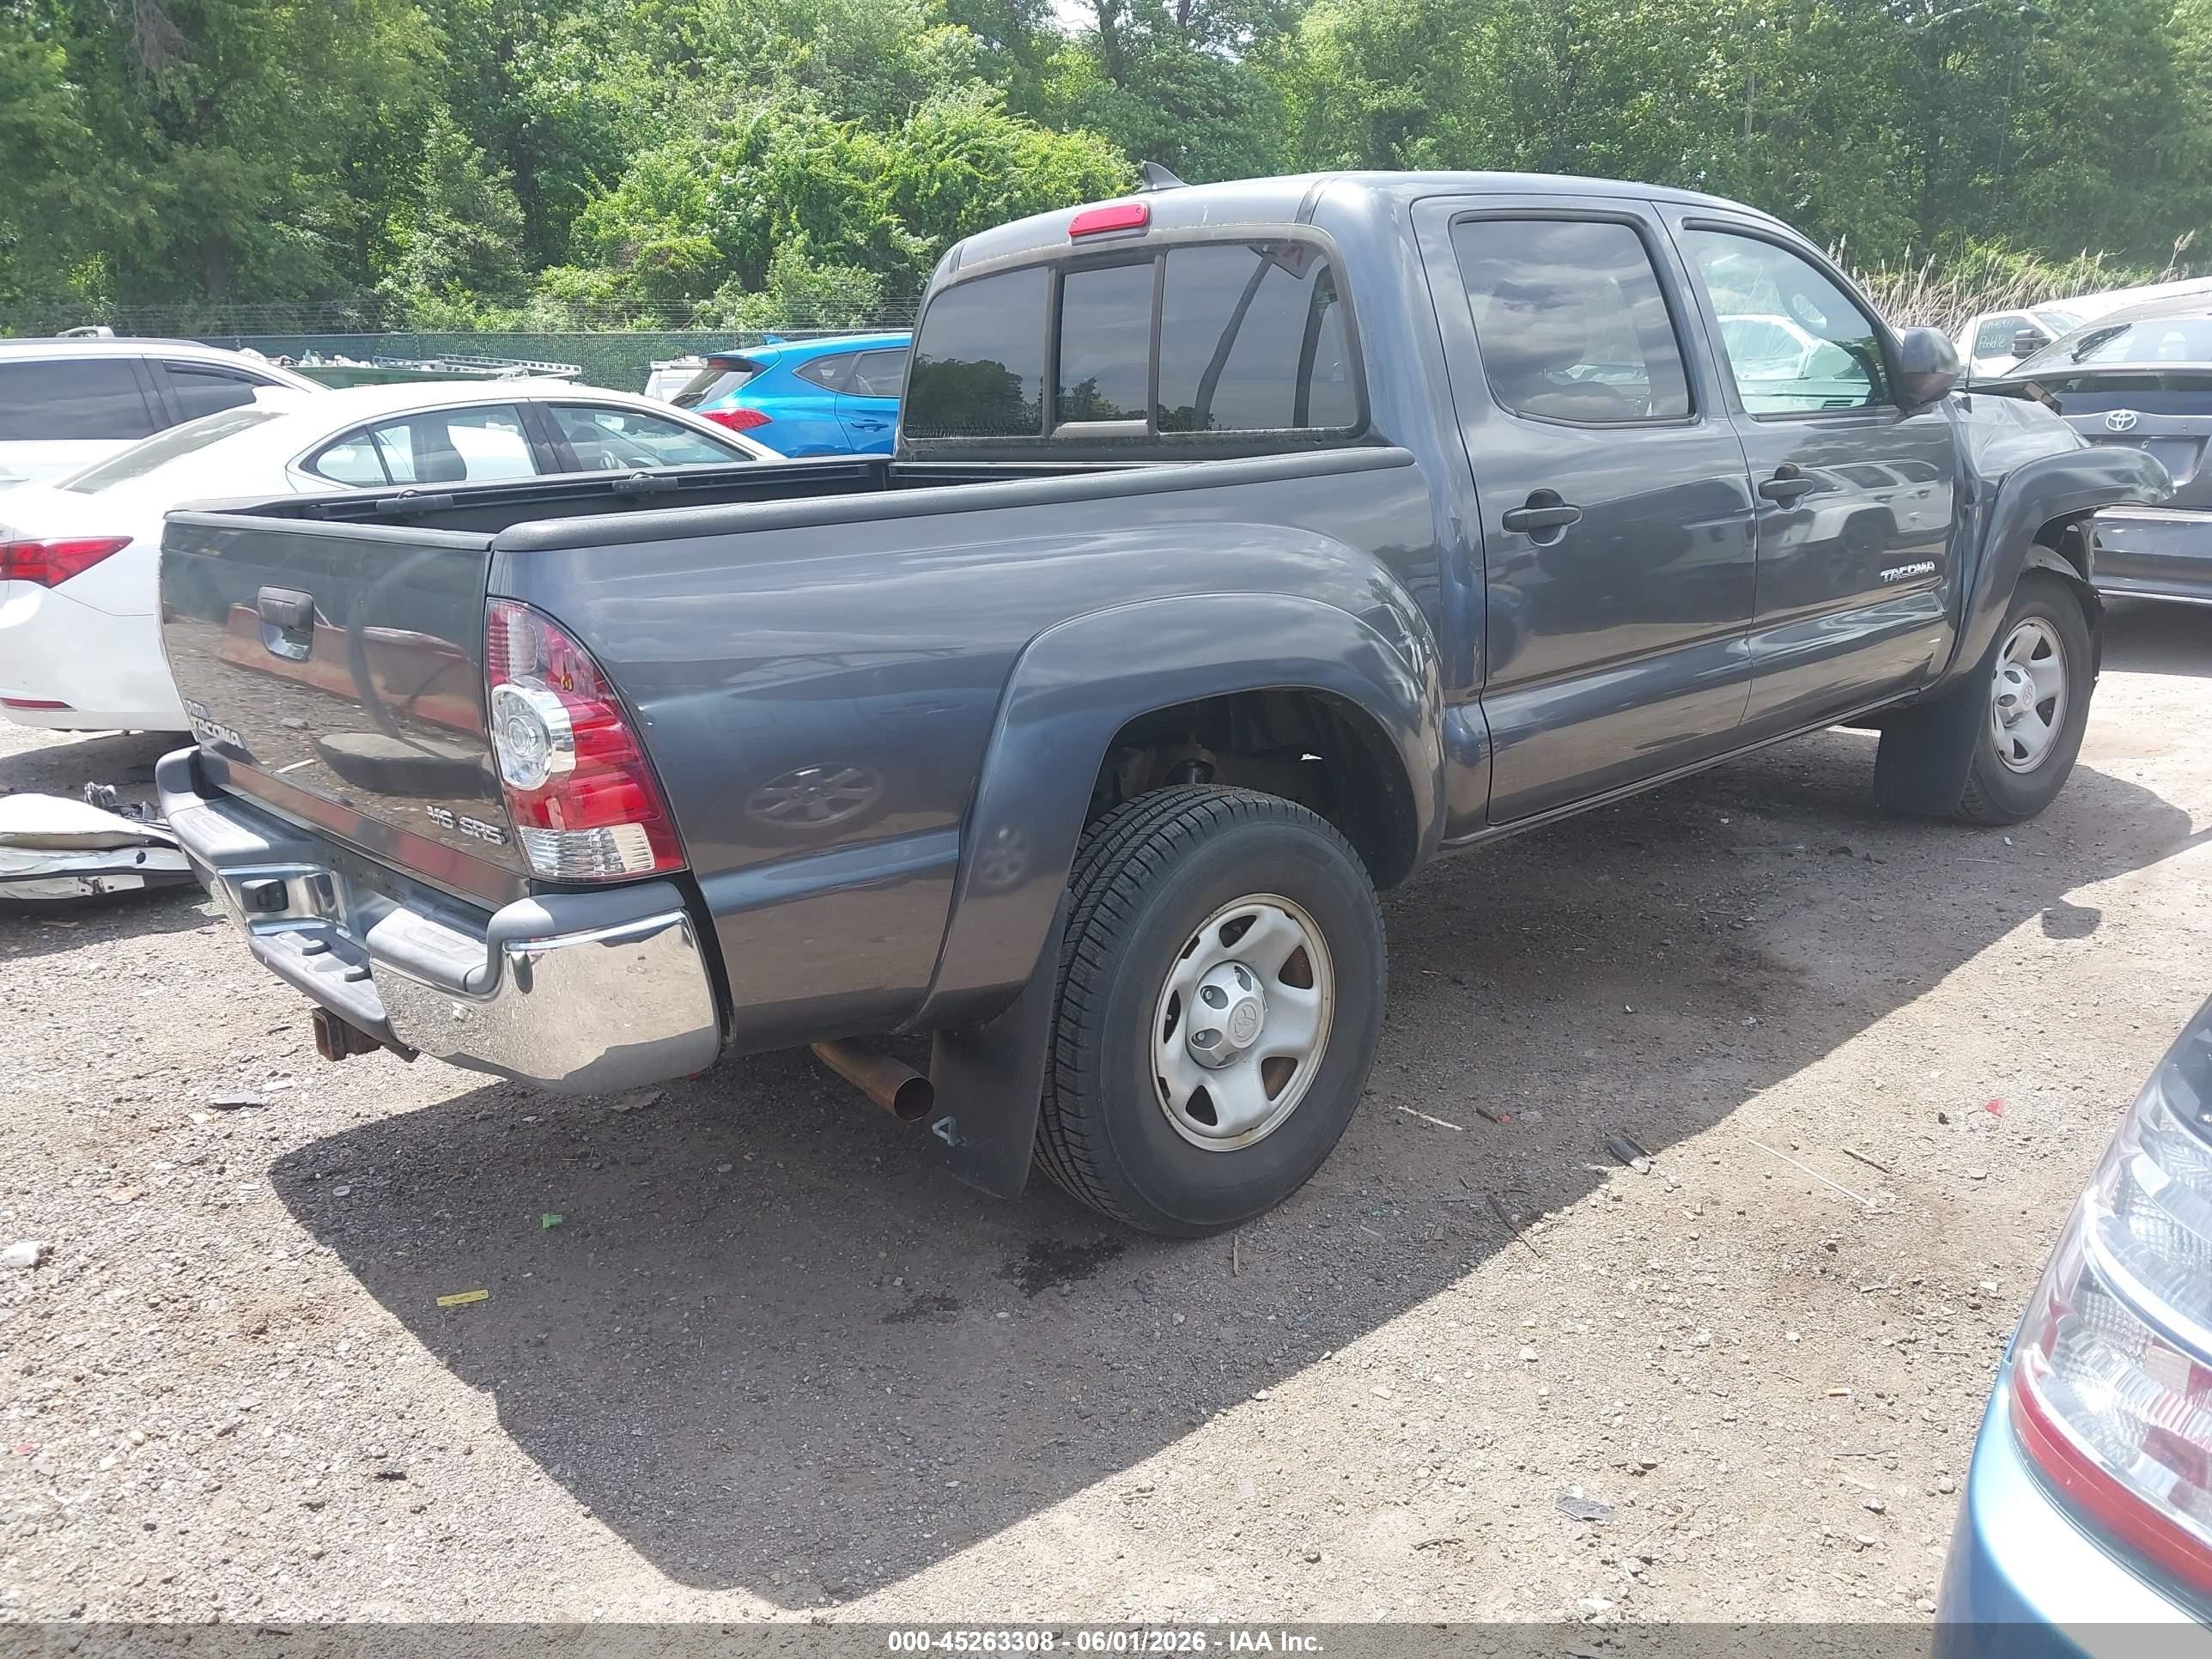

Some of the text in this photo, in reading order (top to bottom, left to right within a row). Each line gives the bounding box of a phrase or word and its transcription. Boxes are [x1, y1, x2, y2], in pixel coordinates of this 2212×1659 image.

[1880, 560, 1936, 582] TACOMA
[190, 714, 246, 750] TACOMA
[426, 805, 508, 846] V6 SR5
